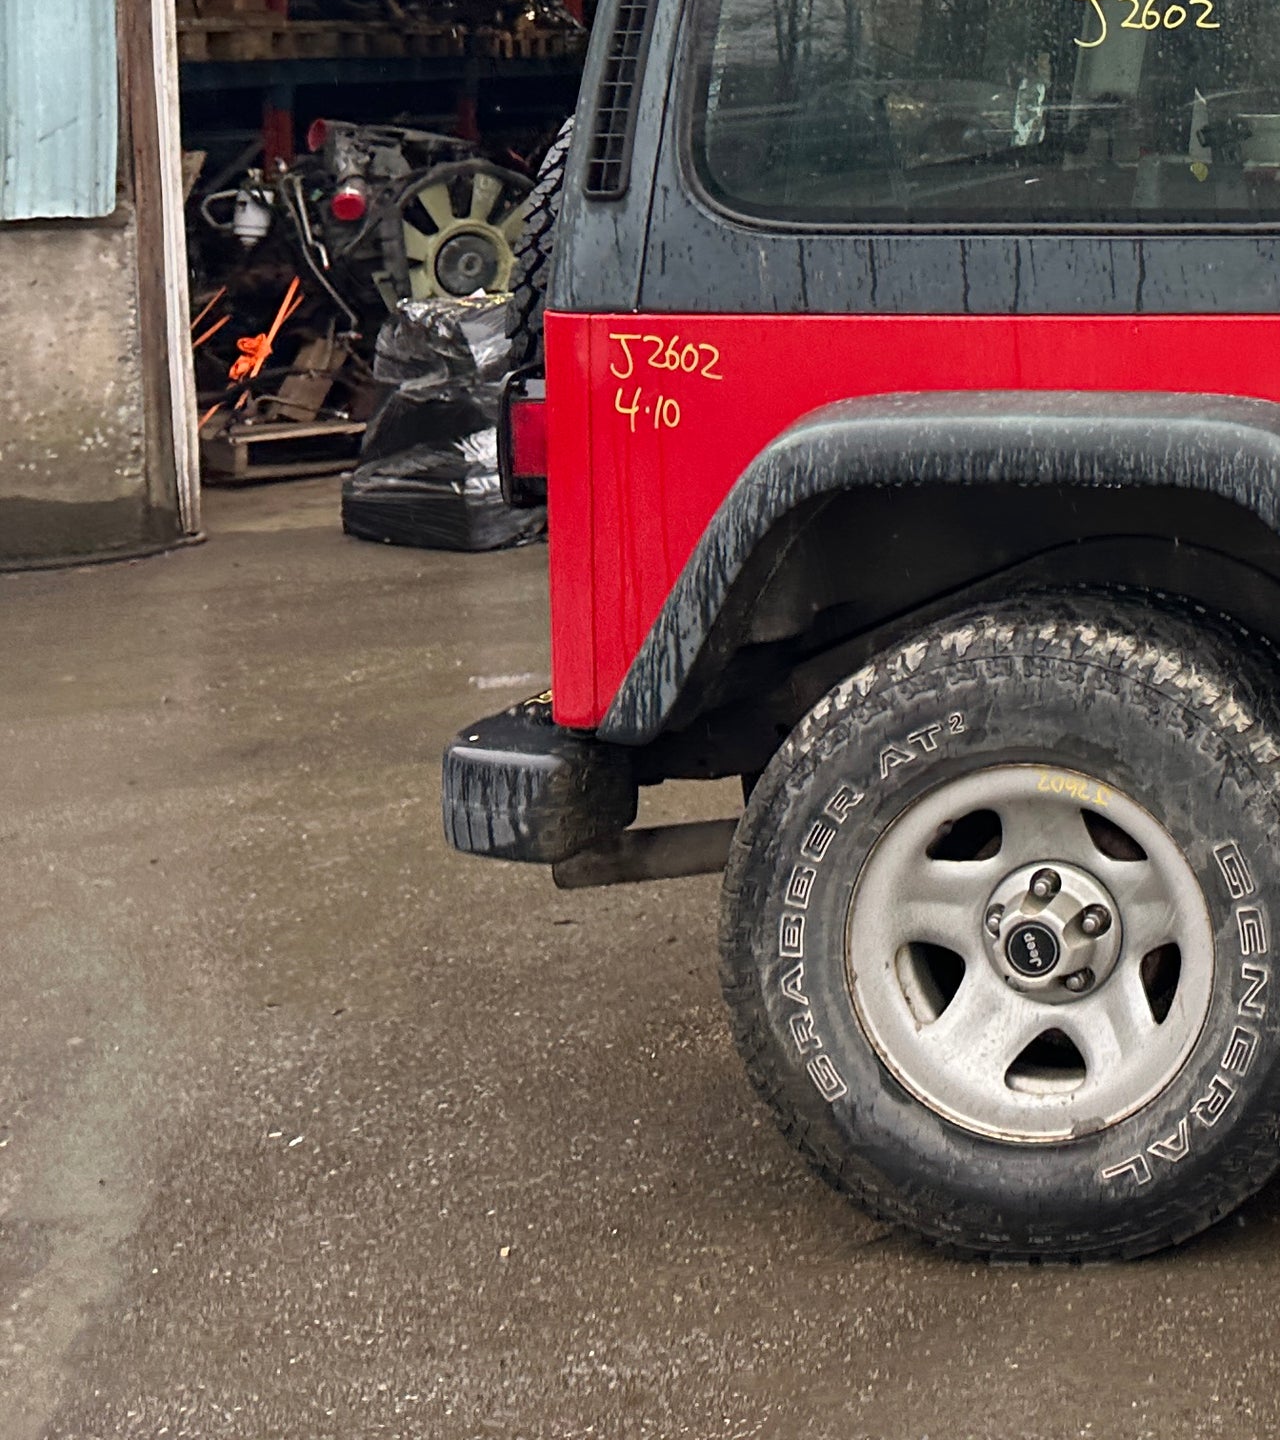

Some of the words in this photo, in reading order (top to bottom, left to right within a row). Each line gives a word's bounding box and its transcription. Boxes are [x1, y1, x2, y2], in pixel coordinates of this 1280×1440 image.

[609, 333, 723, 380] J2602
[779, 785, 864, 1103] GRABBER
[1023, 932, 1042, 967] Jeep
[1101, 843, 1267, 1185] GENERAL
